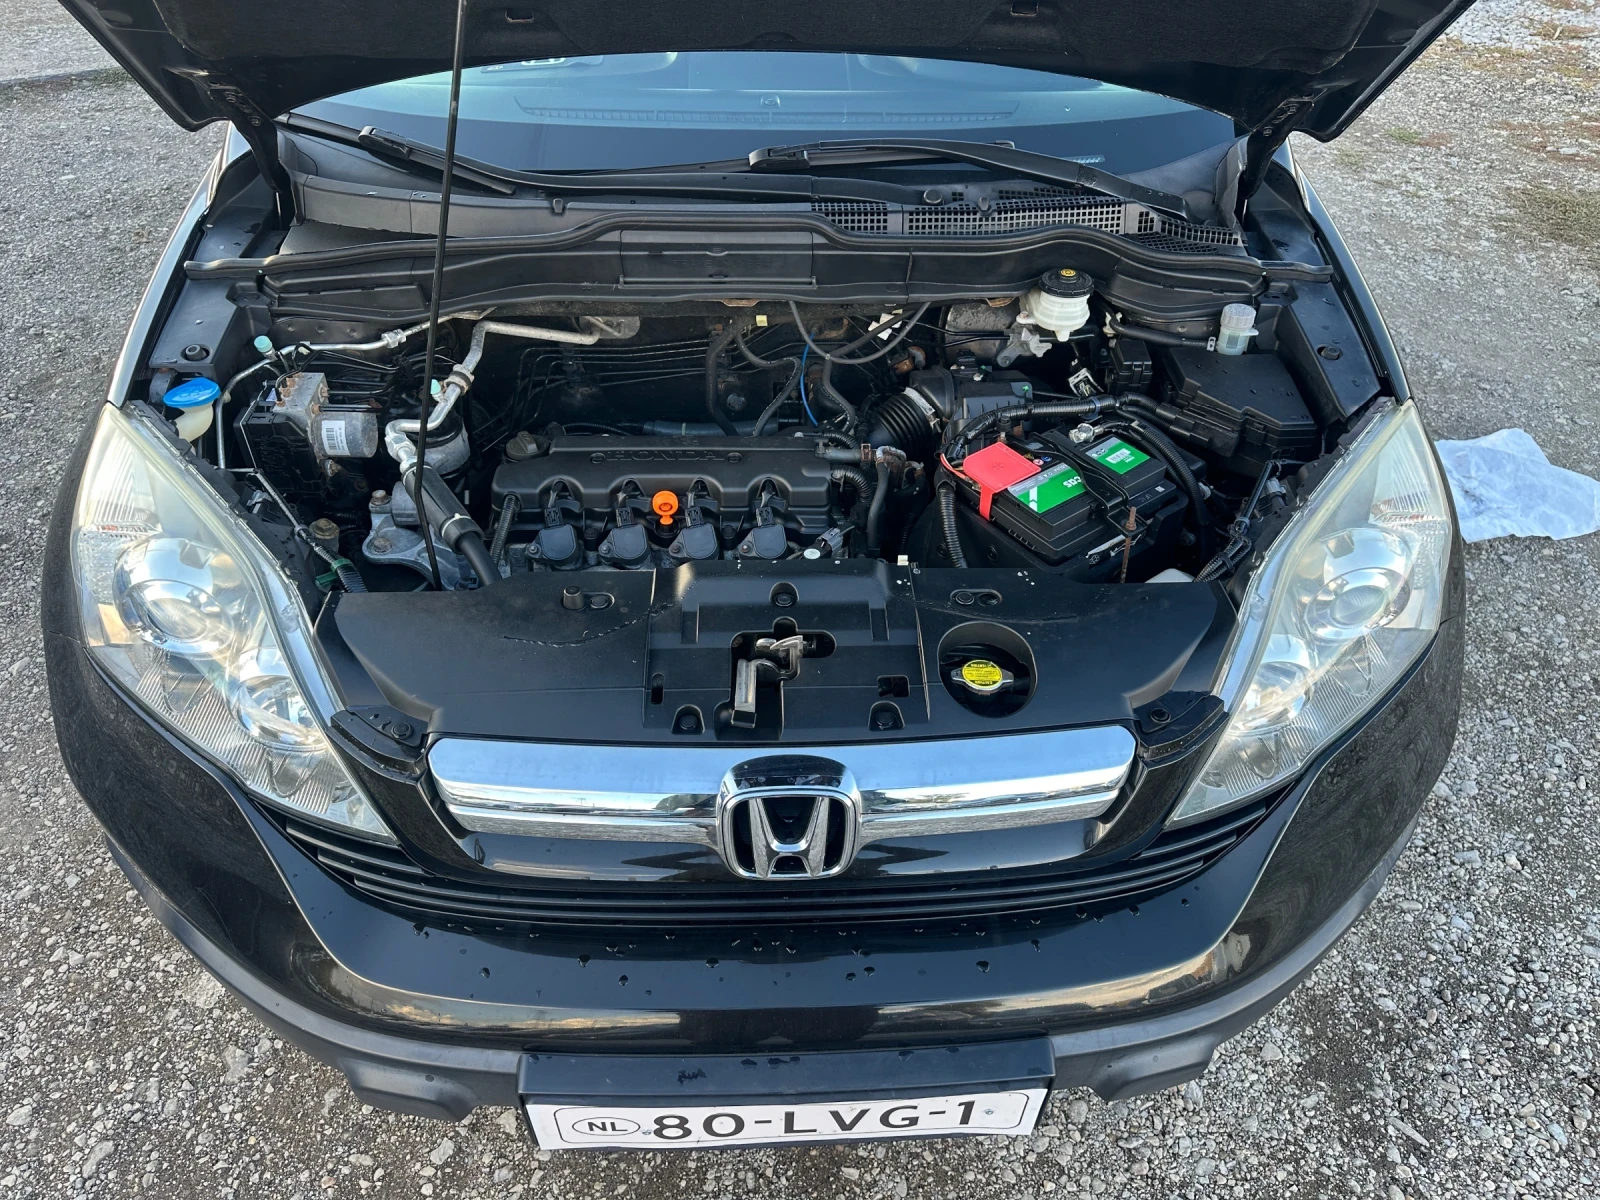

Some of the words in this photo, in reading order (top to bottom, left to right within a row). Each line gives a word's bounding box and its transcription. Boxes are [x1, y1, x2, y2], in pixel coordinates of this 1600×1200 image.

[606, 451, 725, 461] HONDA
[653, 1101, 976, 1140] 80-LVG-1
[587, 1121, 628, 1132] NL
